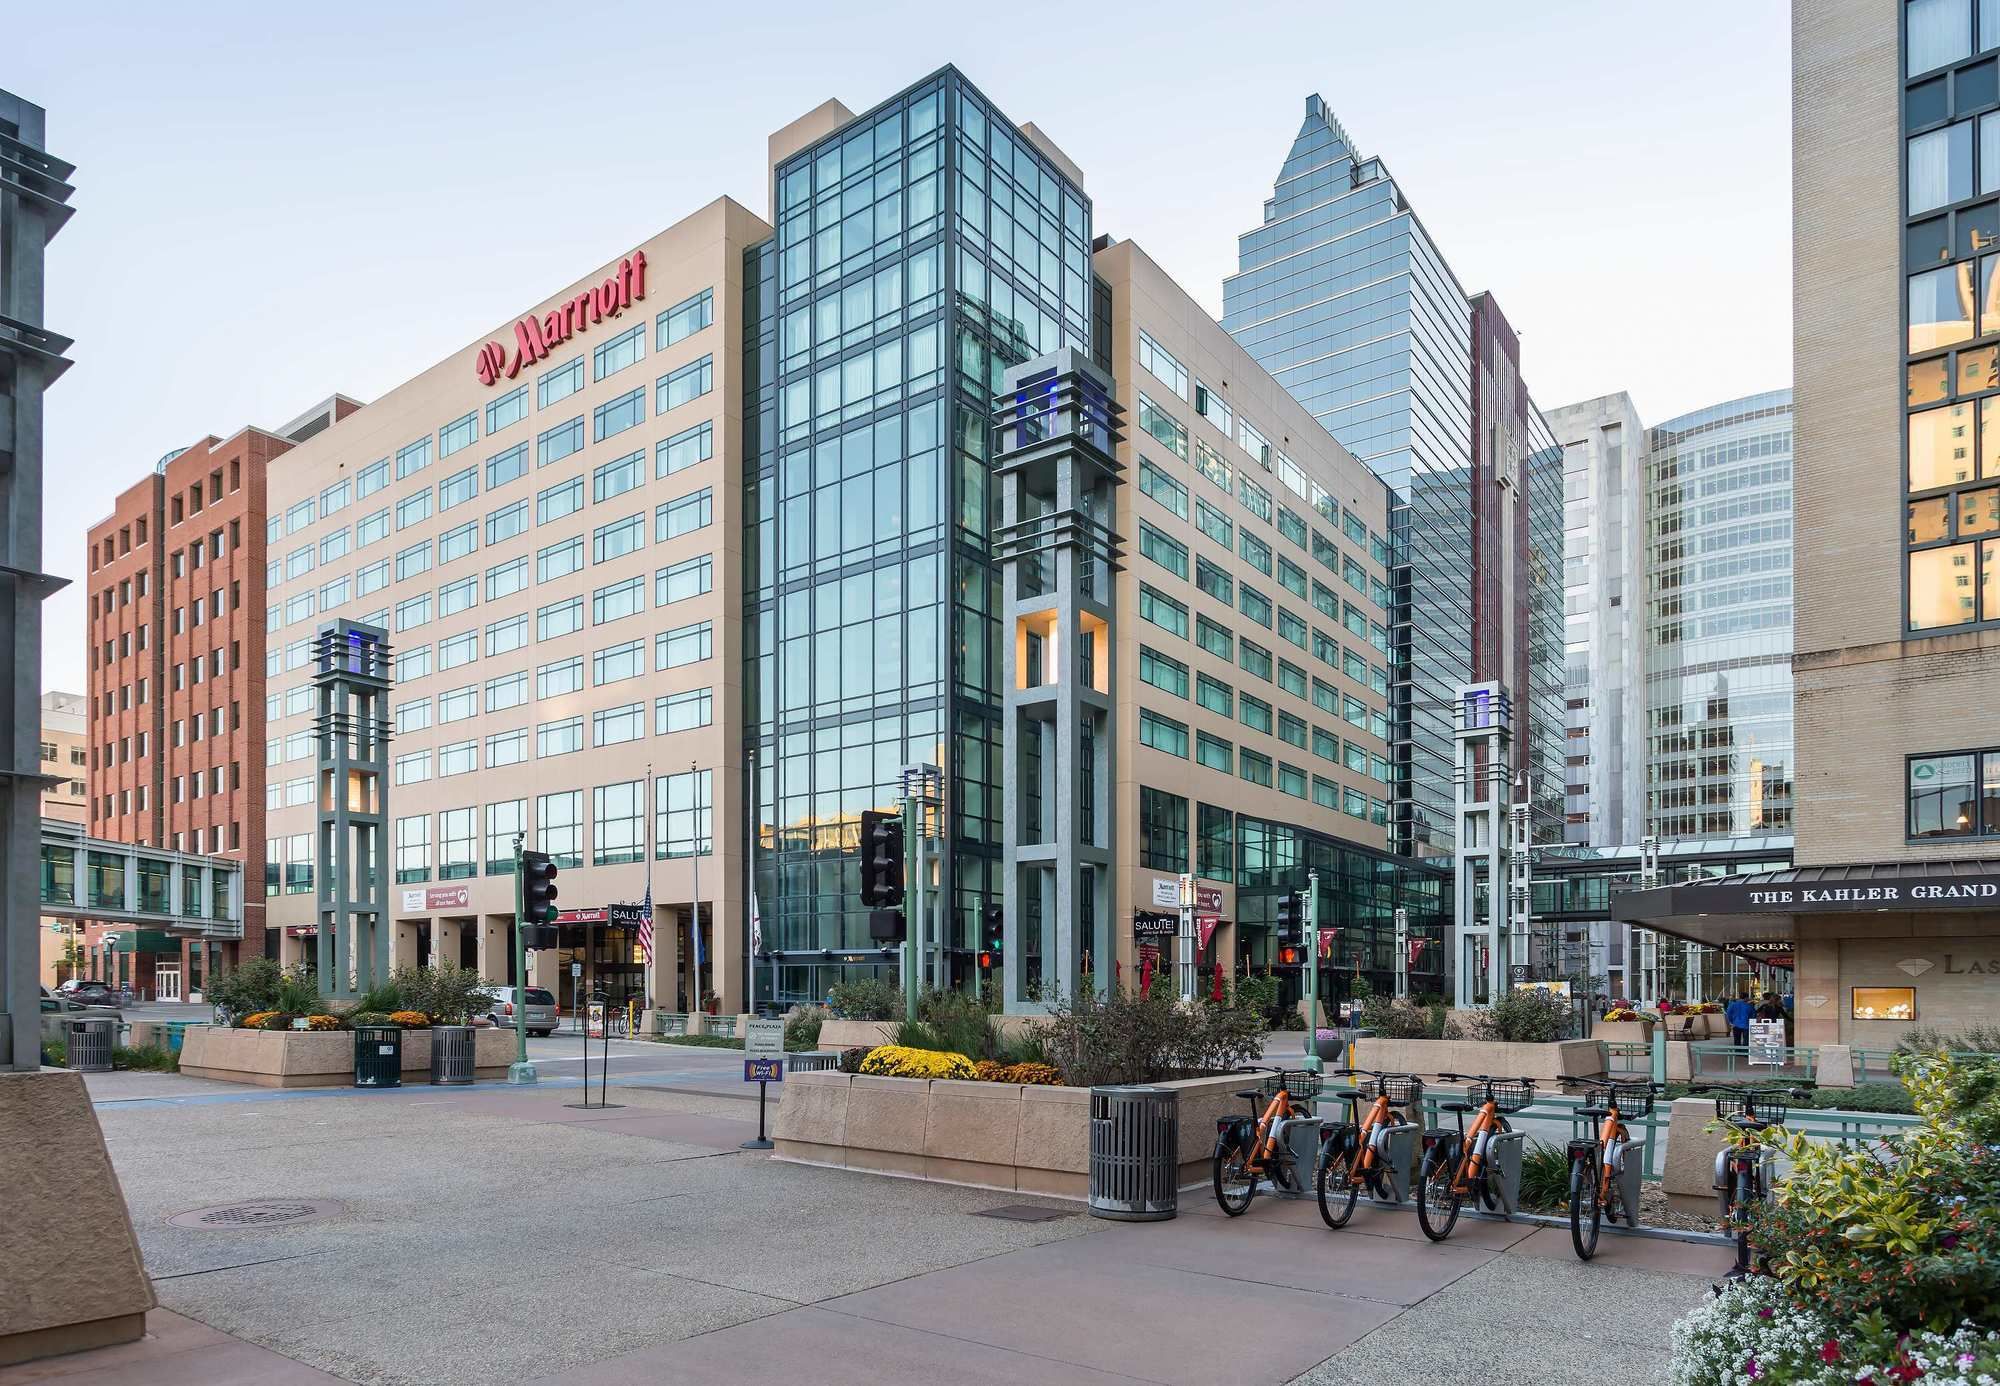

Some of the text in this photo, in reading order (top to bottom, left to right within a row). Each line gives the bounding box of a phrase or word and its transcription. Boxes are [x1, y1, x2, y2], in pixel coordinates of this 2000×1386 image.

[505, 250, 647, 379] Marriott
[1750, 884, 1998, 904] THE KAHLER GRAND
[612, 910, 641, 920] SALUT
[1135, 918, 1174, 930] SALUTE!
